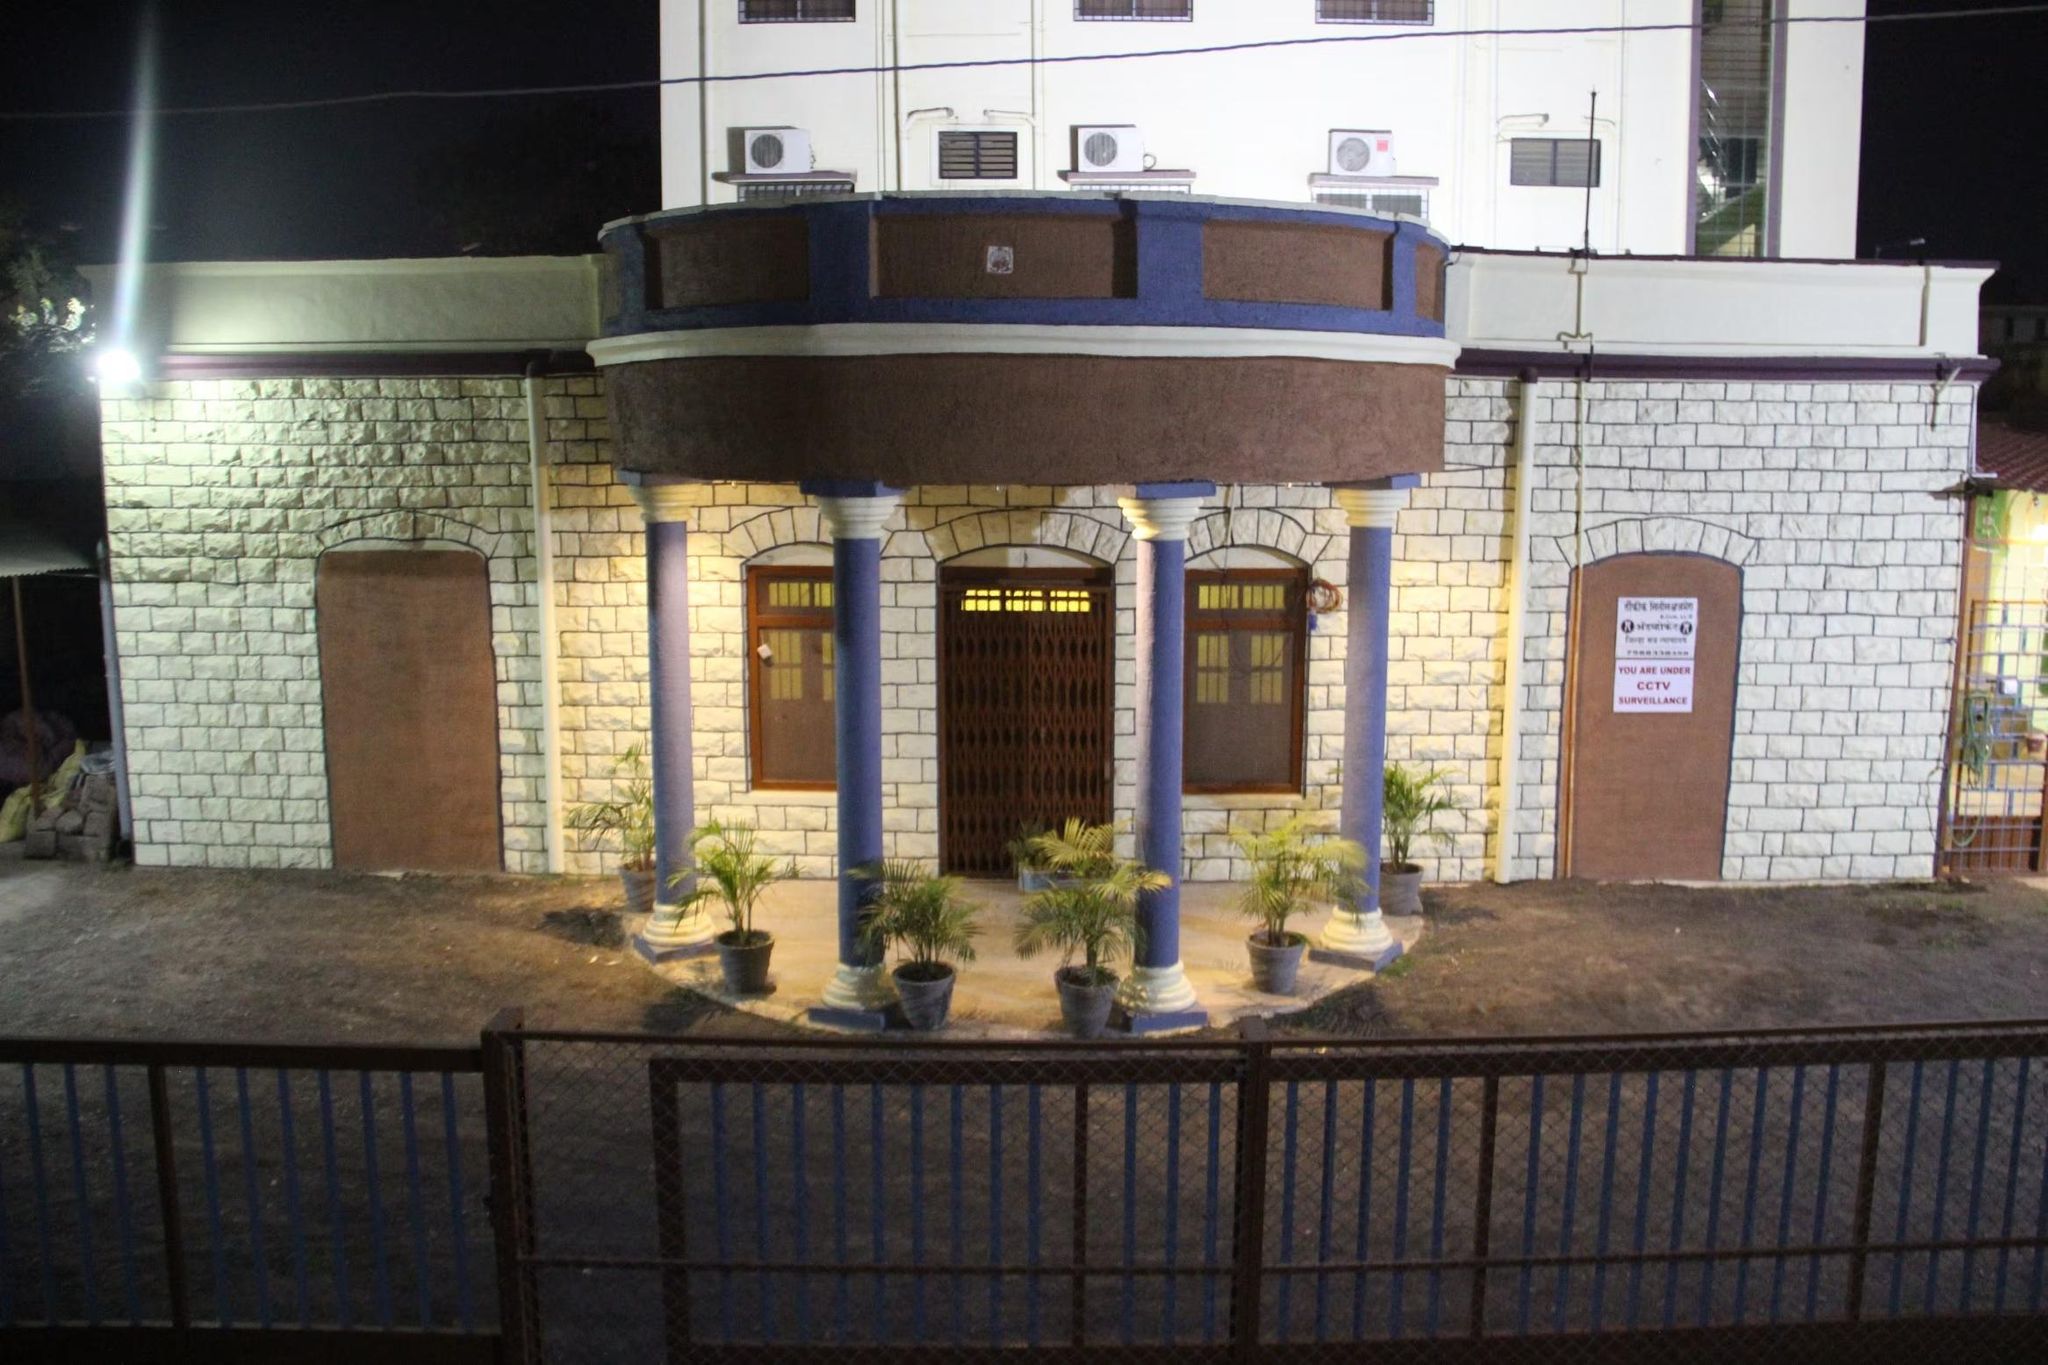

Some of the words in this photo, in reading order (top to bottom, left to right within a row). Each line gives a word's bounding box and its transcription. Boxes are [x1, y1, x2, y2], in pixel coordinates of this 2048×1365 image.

[1619, 667, 1637, 675] YOU
[1640, 667, 1657, 675] ARE
[1660, 667, 1690, 675] UNDER
[1637, 682, 1671, 691] CCTV
[1618, 697, 1687, 705] SURVEILLANCE
